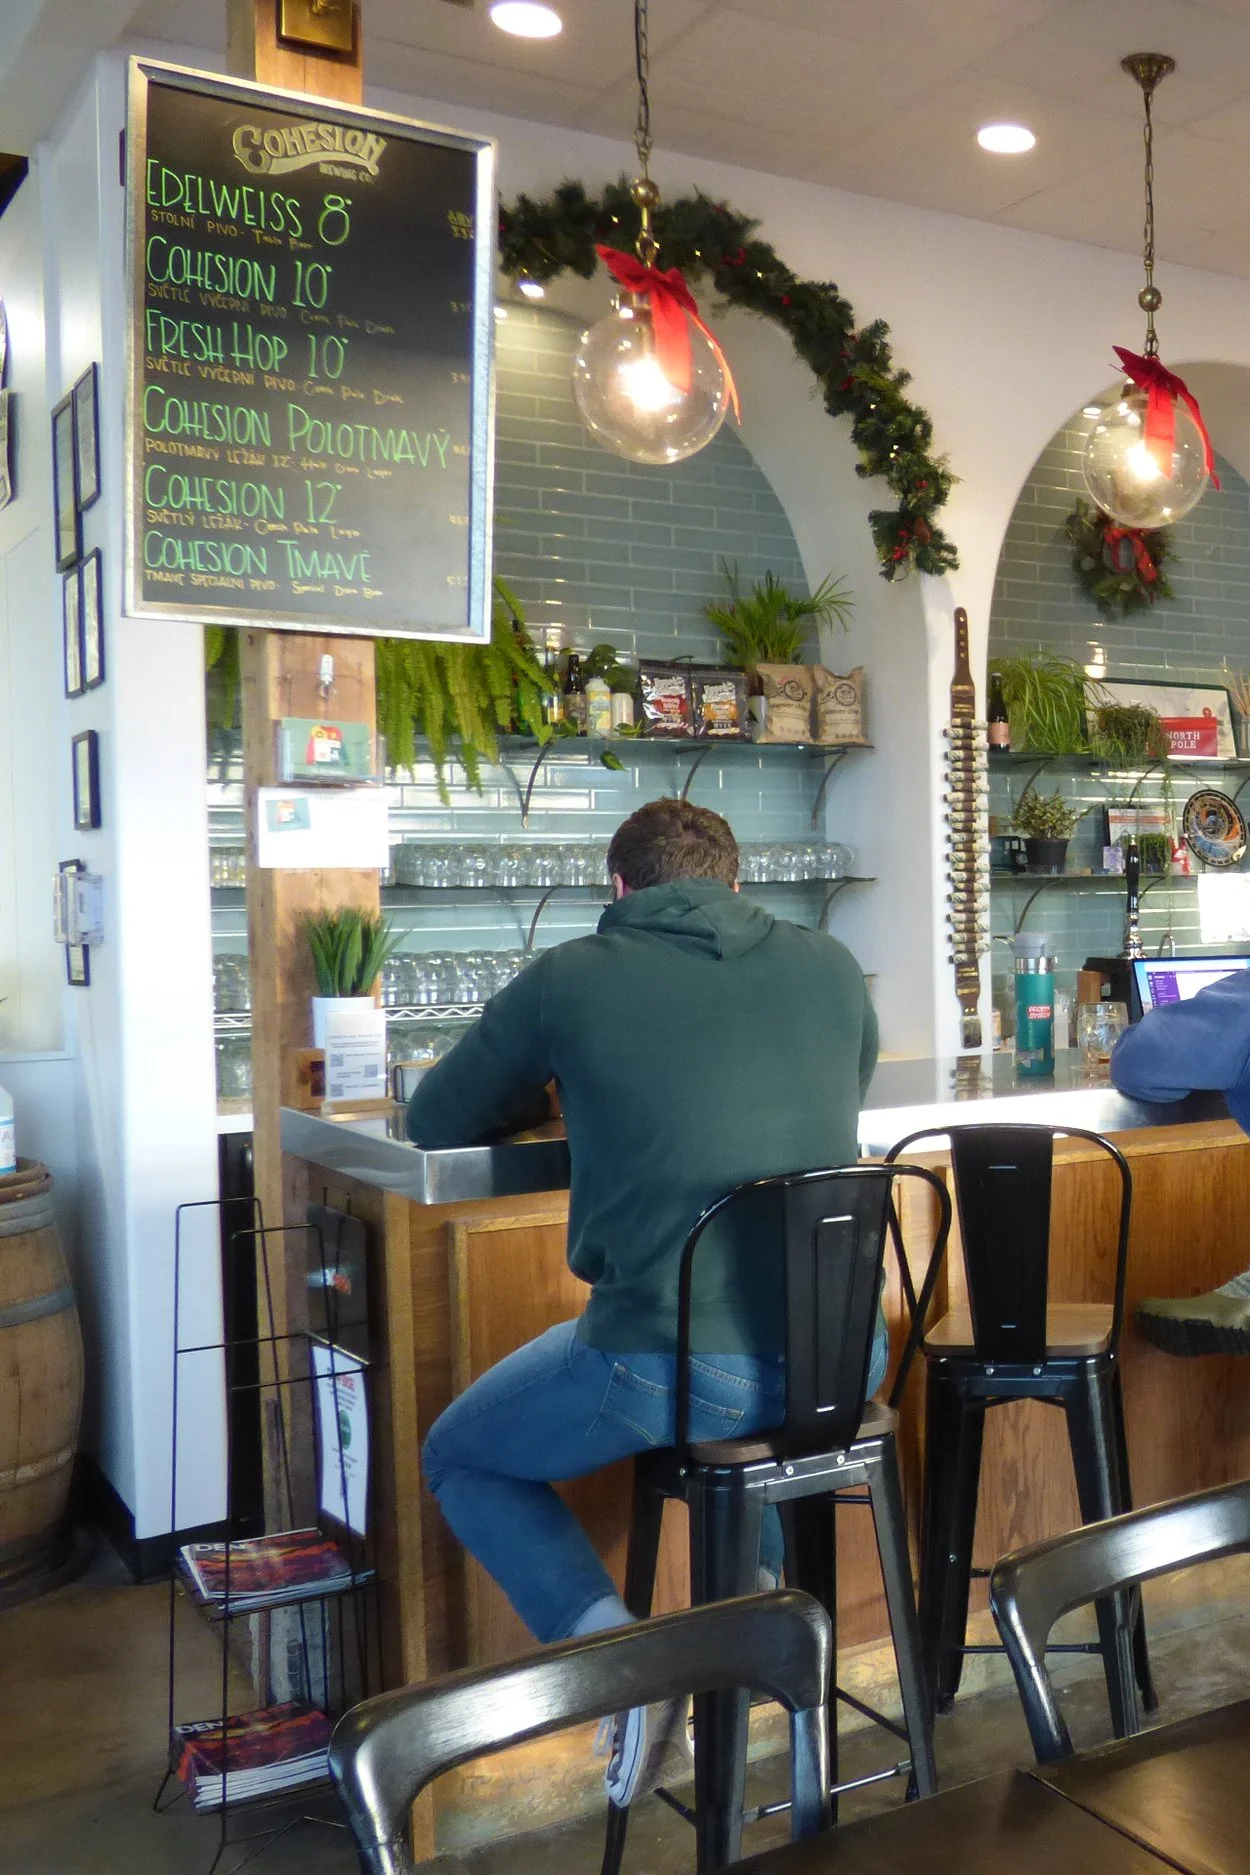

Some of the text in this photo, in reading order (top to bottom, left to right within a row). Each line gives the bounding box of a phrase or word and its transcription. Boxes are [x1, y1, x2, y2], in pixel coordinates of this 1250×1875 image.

[232, 123, 387, 174] COHESION
[147, 159, 303, 237] EDELWEISS
[147, 236, 276, 302] COHESION
[146, 309, 224, 363] FRESH
[230, 322, 288, 373] HOP
[144, 385, 450, 469] COHESION POLOTMAVÝ
[145, 464, 284, 520] COHESION
[144, 530, 267, 575] COHESION
[1165, 731, 1201, 740] NORTH
[1170, 740, 1196, 749] POLE
